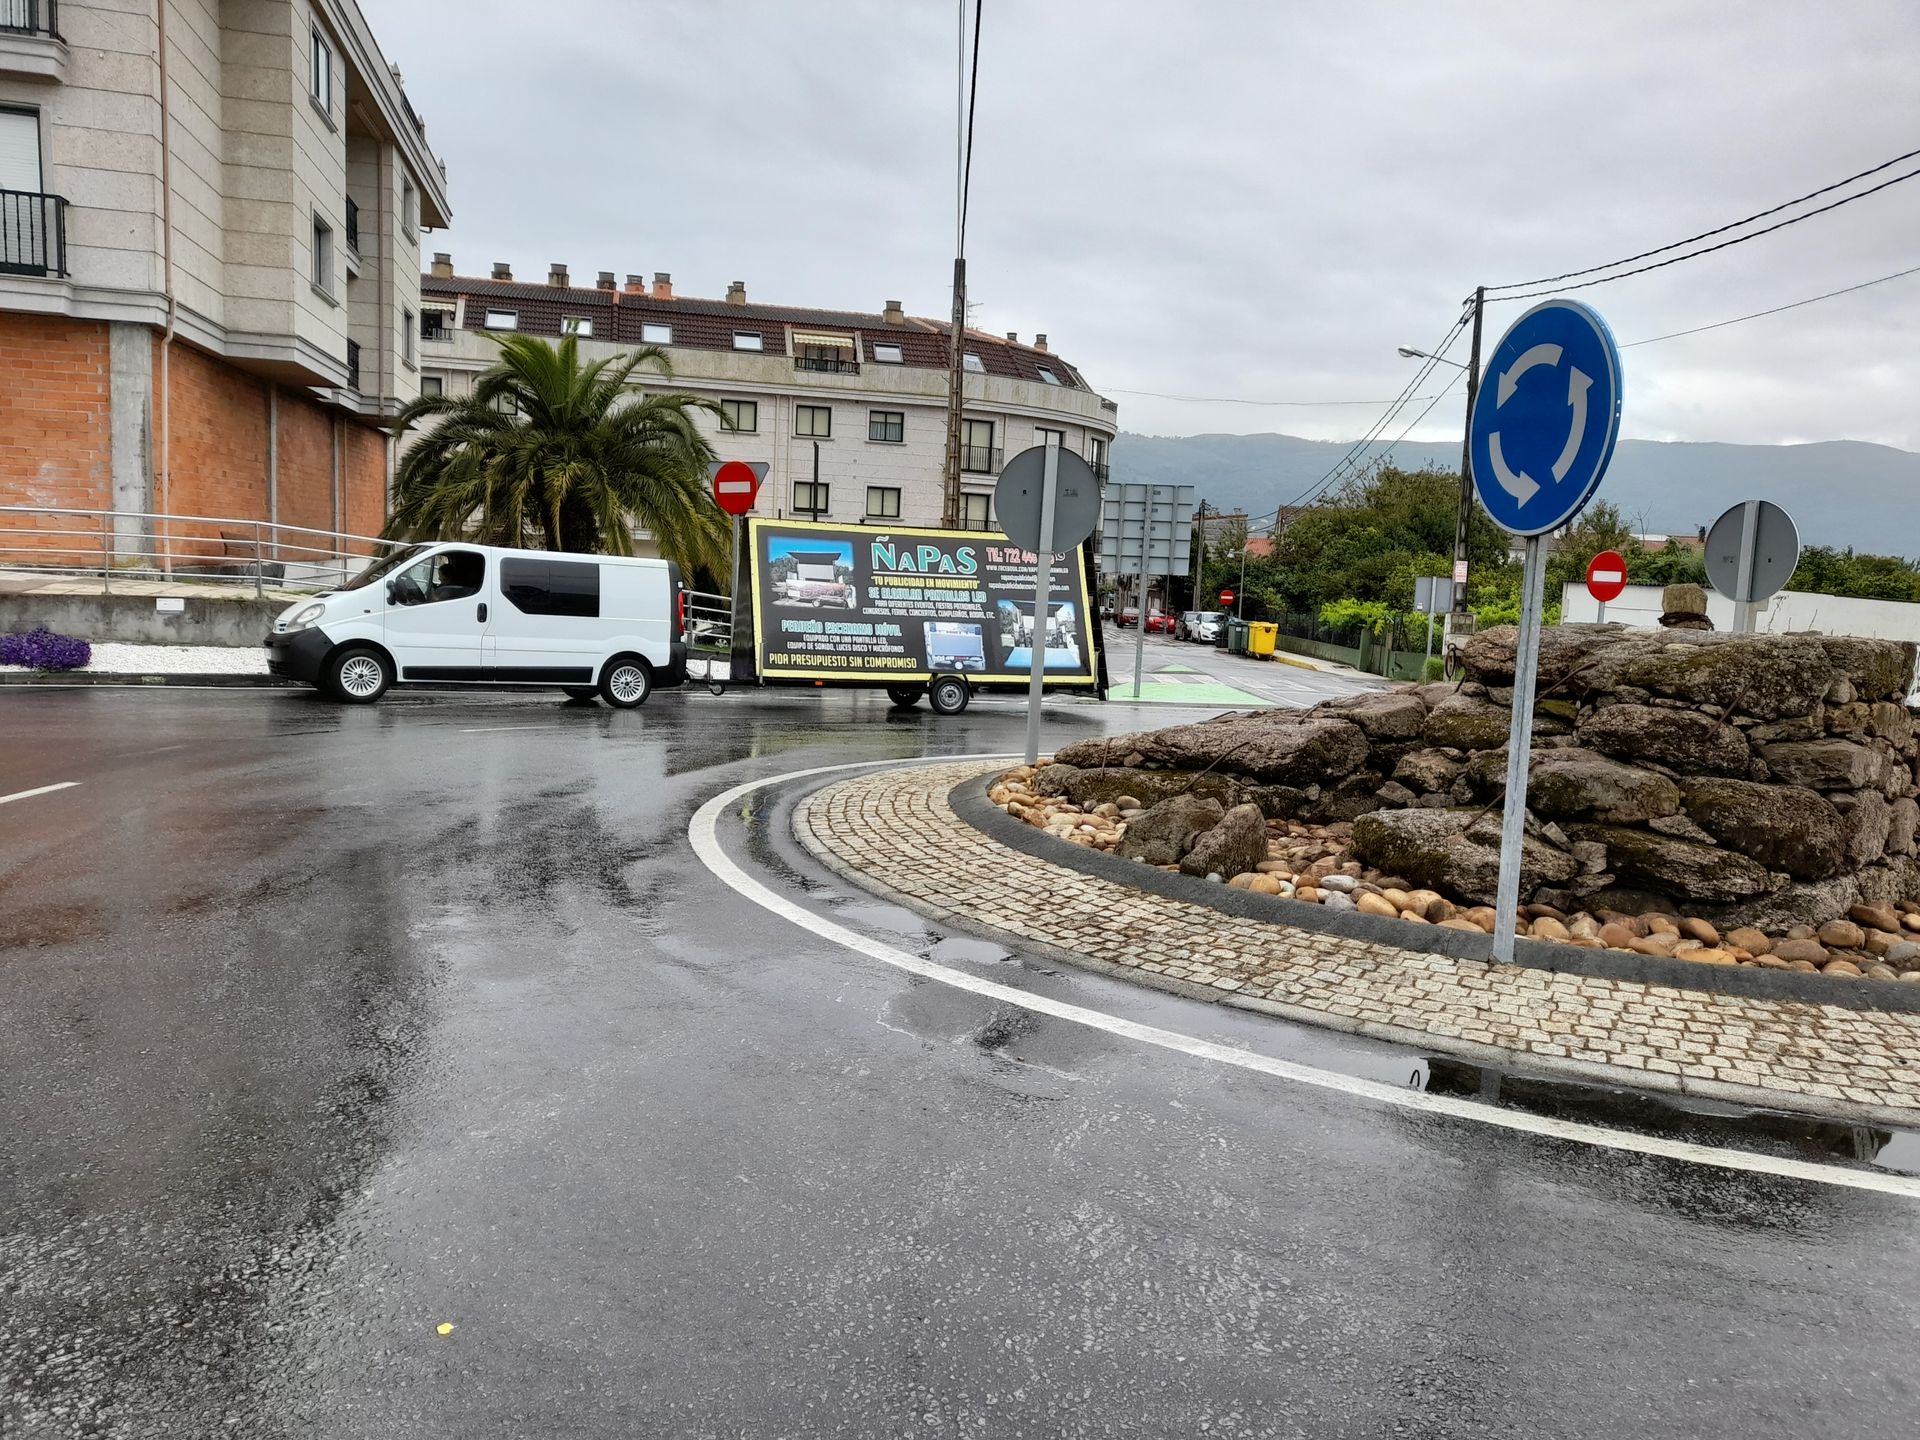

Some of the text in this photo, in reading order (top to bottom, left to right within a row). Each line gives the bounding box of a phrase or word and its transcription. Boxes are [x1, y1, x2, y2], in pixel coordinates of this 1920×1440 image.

[1004, 547, 1021, 564] 722
[885, 577, 924, 587] PUBLICIDAD
[926, 579, 934, 588] EN
[868, 587, 987, 603] SE ALQUILAN PANTALLAS LED
[781, 619, 902, 636] PEQUEÑO ESCENARIO MÓVIL
[787, 641, 806, 650] EQUIPO
[807, 642, 814, 650] DE
[836, 644, 852, 652] LUCES
[852, 644, 868, 652] DISCO
[803, 633, 829, 642] EQUIPADO
[829, 635, 840, 643] CON
[841, 635, 852, 643] UNA
[852, 636, 877, 644] PANTALLA
[769, 653, 917, 669] PIDA PRESUPUESTO SIN COMPROMISO
